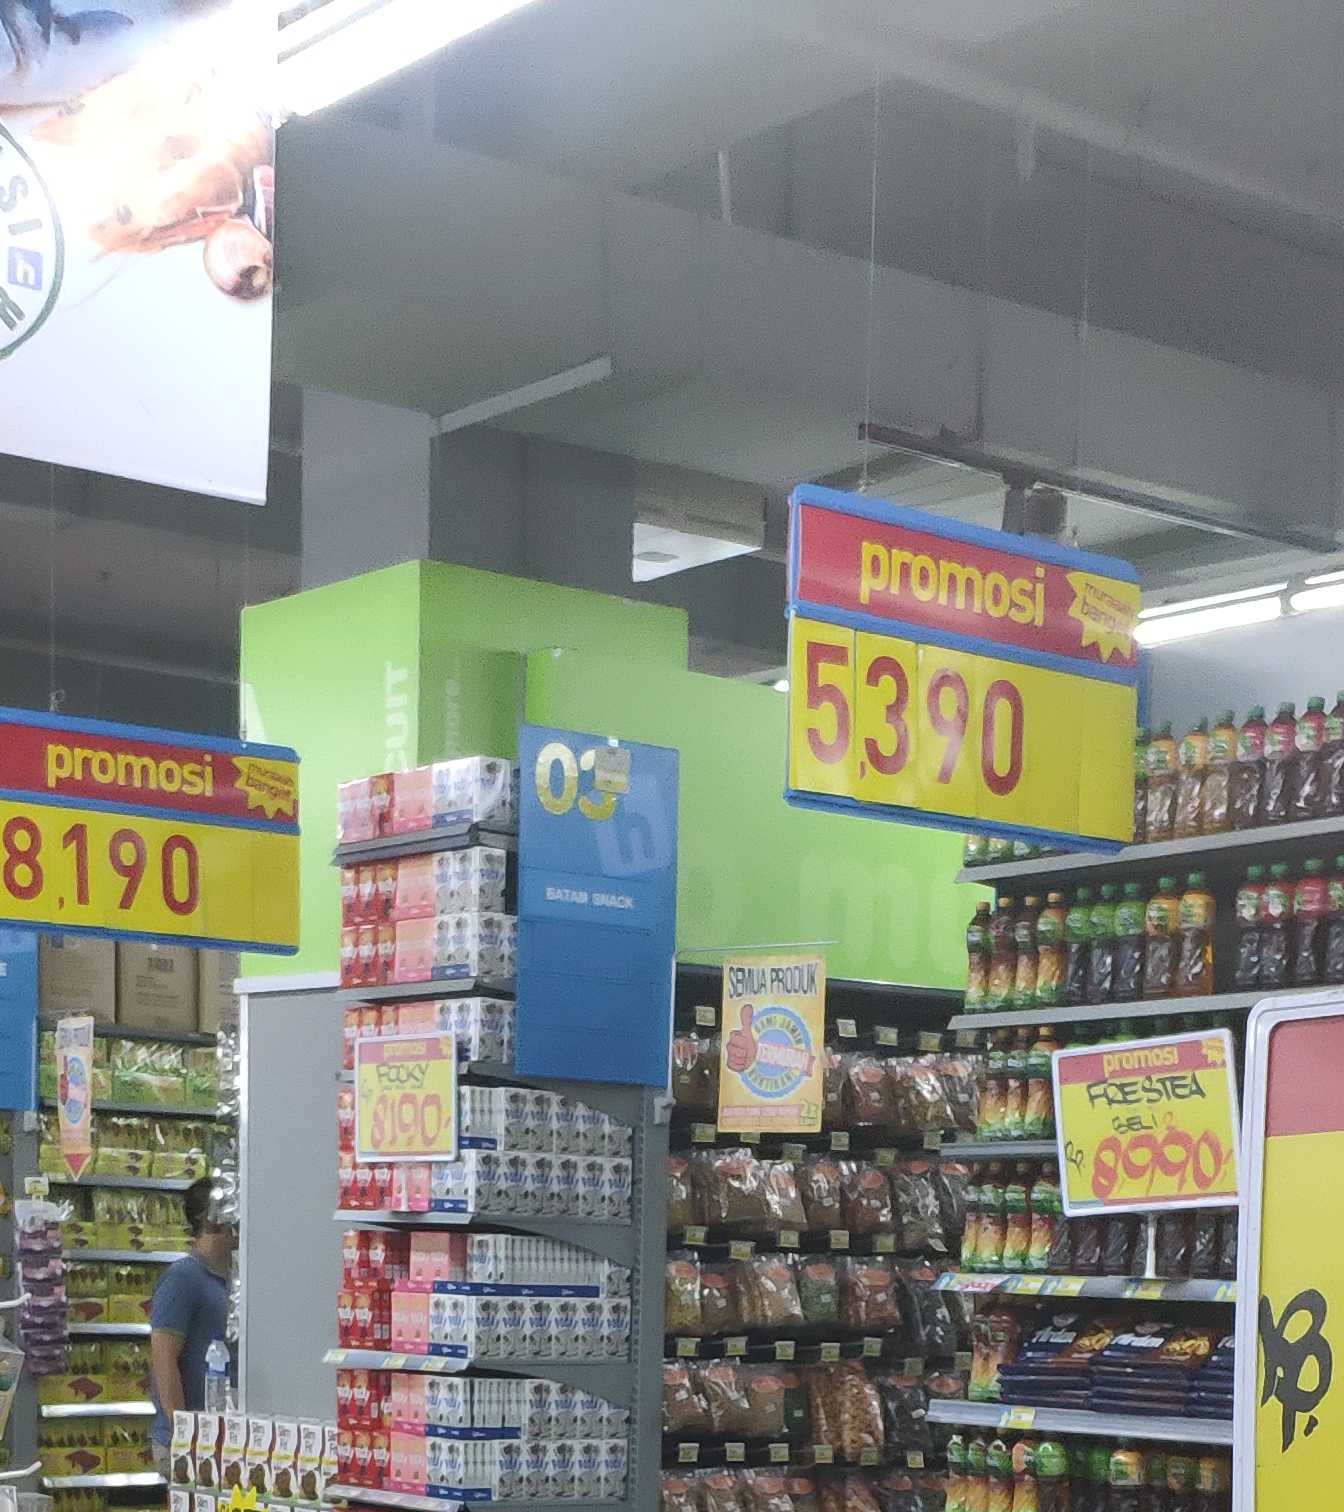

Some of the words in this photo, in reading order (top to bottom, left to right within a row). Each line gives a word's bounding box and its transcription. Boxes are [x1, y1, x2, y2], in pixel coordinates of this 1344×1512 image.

[860, 541, 1045, 627] promosi
[806, 640, 1024, 796] 5,390
[47, 743, 213, 797] promosi
[3, 816, 201, 916] 8,190
[728, 965, 767, 1000] SEMUA
[770, 962, 819, 996] PRODUK
[1102, 1046, 1179, 1077] promosi
